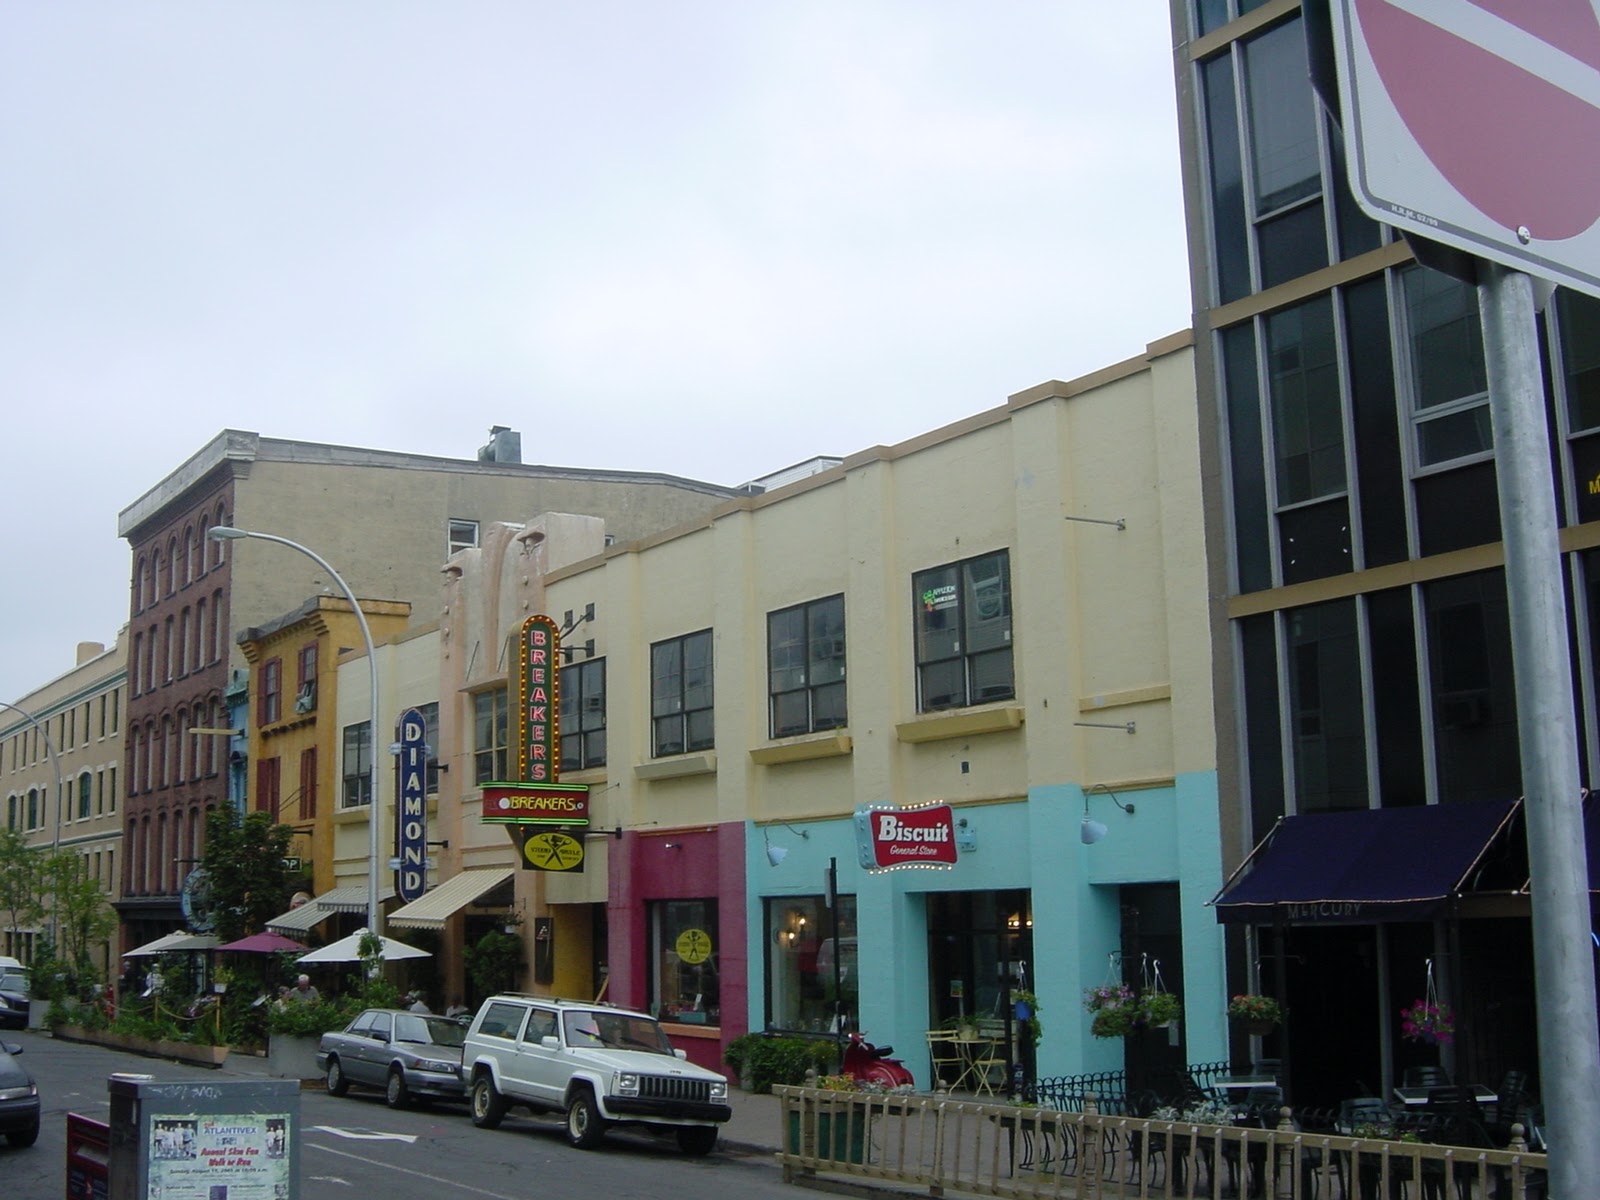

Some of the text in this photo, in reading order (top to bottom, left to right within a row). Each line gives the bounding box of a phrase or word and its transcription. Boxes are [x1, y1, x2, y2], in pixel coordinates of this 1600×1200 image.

[530, 630, 547, 780] BREAKERS
[405, 722, 422, 891] DIAMOND
[510, 796, 576, 811] BREAKERS
[878, 815, 949, 842] Biscuit
[890, 845, 938, 855] General Store
[1287, 903, 1361, 920] MERCURY
[204, 1127, 257, 1135] ATLANTIVEX
